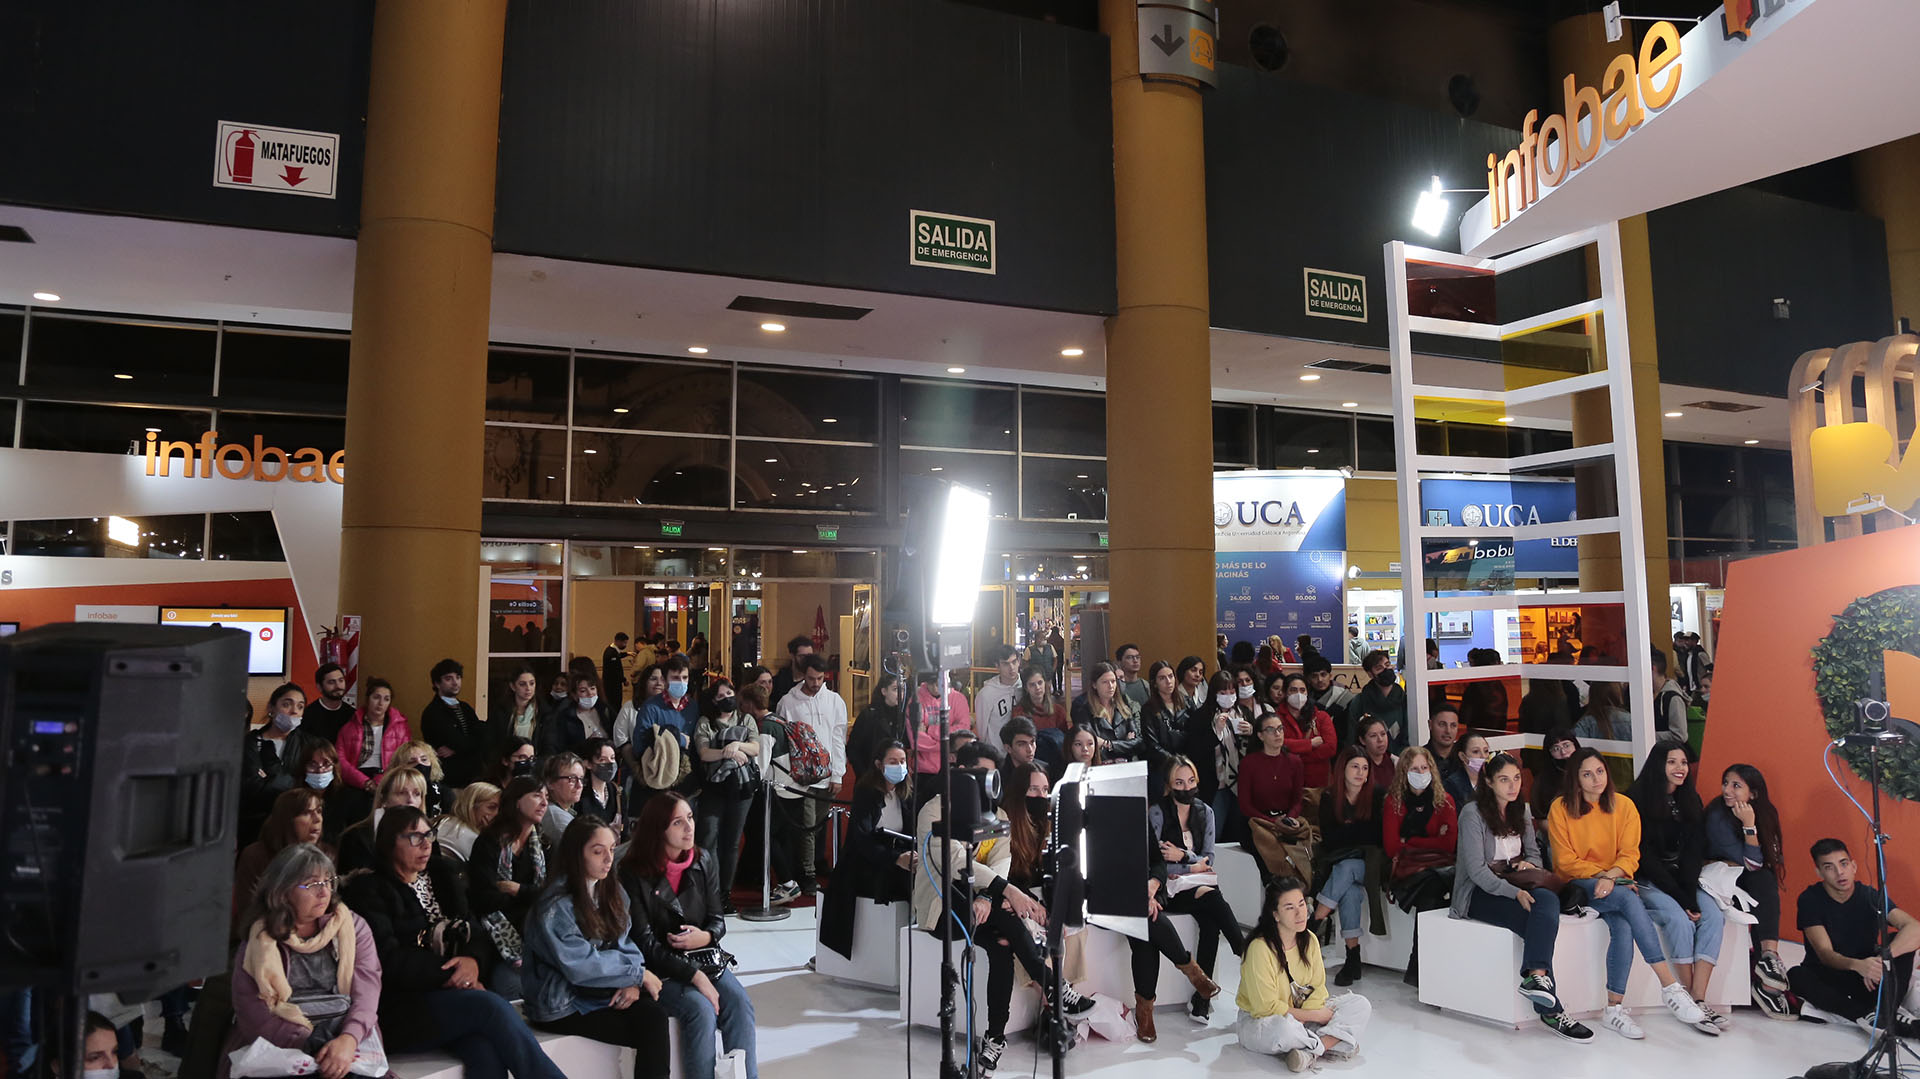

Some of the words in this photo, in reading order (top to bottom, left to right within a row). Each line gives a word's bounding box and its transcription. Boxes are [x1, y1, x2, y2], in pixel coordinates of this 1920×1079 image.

[1487, 20, 1682, 229] infobae
[261, 141, 331, 166] MATAFUEGOS
[918, 222, 988, 251] SALIDA
[918, 246, 930, 255] DE
[932, 248, 988, 262] EMERGENCIA
[1310, 279, 1361, 303] SALIDA
[1310, 299, 1320, 307] DE
[1320, 300, 1362, 312] EMERGENCIA
[1236, 500, 1306, 525] UCA
[1482, 503, 1542, 528] UCA
[662, 525, 682, 534] SALIDA
[818, 530, 837, 538] SALIDA
[1222, 560, 1240, 569] MÁS
[87, 611, 118, 620] infobae
